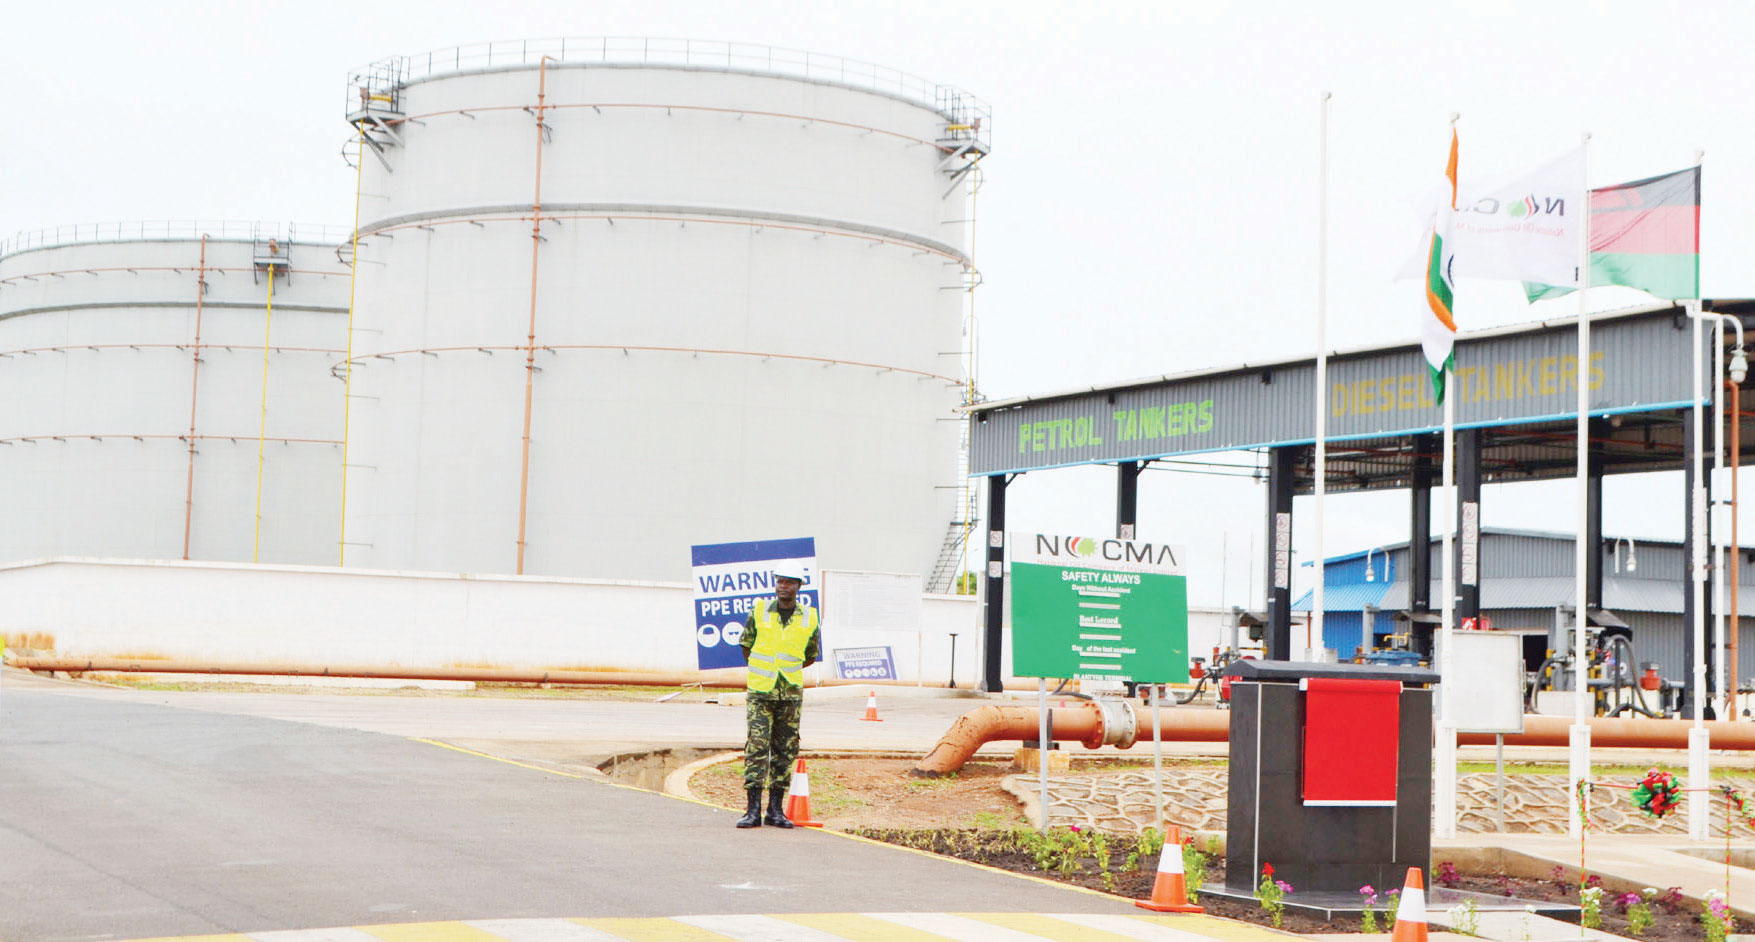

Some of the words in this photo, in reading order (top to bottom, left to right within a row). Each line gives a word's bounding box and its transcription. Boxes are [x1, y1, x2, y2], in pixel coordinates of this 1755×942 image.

[1332, 372, 1433, 417] DIESEL
[1454, 351, 1605, 404] TANKERS
[1019, 416, 1103, 453] PETROL
[1113, 399, 1214, 441] TANKERS
[699, 568, 811, 593] WARNI
[1062, 571, 1100, 583] SAFETY
[1101, 573, 1141, 585] ALWAYS
[701, 600, 731, 617] PPE
[843, 651, 881, 660] WARNING
